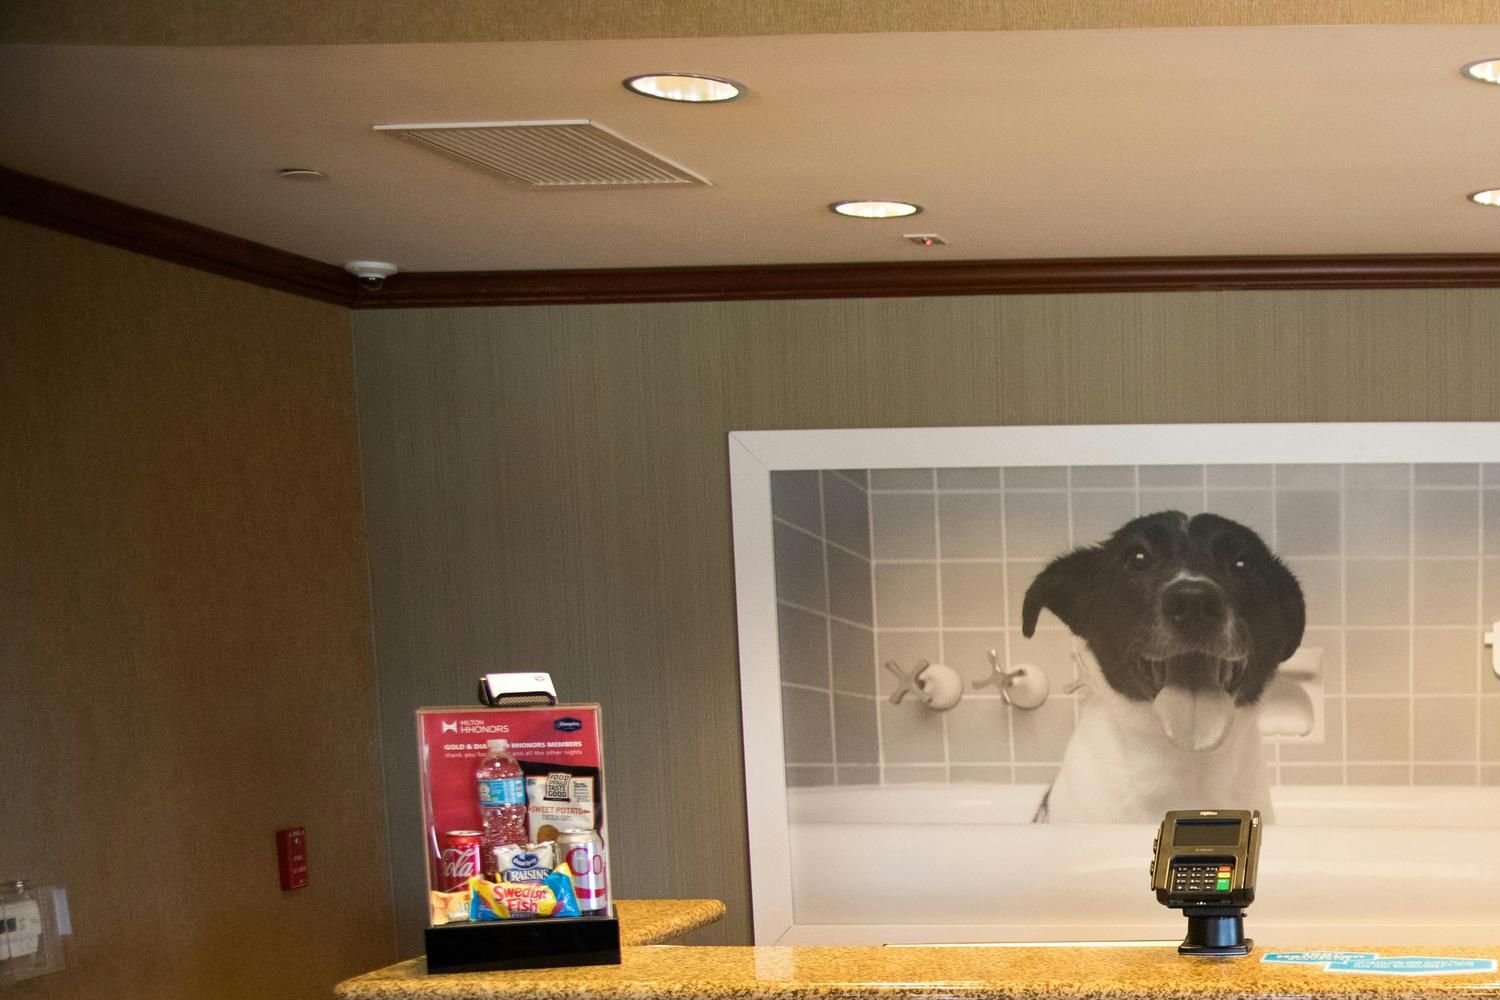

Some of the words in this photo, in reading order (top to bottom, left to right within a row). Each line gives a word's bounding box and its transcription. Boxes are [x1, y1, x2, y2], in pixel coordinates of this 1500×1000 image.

[460, 725, 510, 734] HHONORS
[564, 748, 583, 757] nights
[556, 807, 582, 815] POTATO
[493, 885, 547, 903] Swedish
[508, 899, 538, 913] Fish
